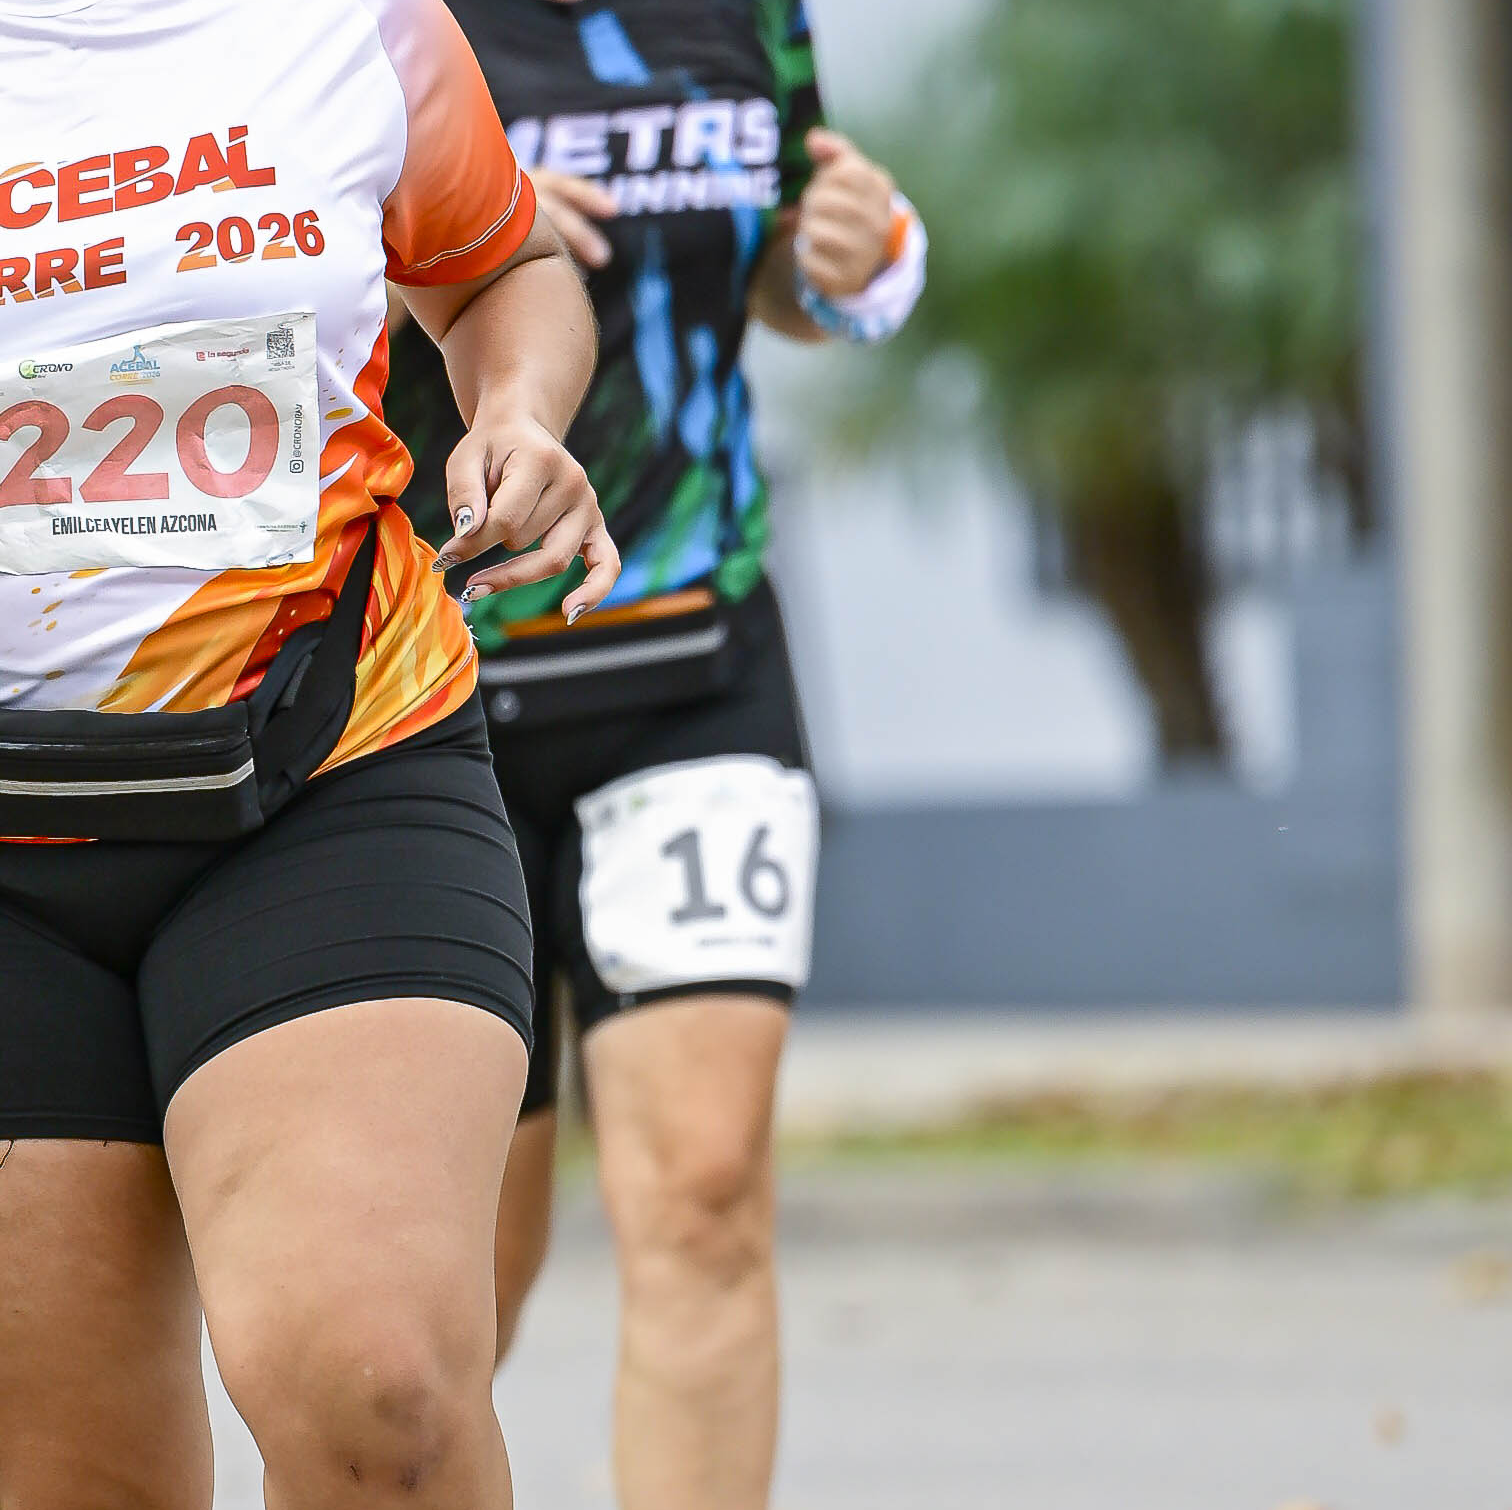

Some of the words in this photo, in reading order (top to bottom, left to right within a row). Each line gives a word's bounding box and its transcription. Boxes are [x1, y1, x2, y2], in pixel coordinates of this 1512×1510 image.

[175, 209, 326, 273] 2026
[110, 359, 161, 373] ACEBAL
[160, 513, 217, 534] AZCONA
[659, 822, 792, 926] 16
